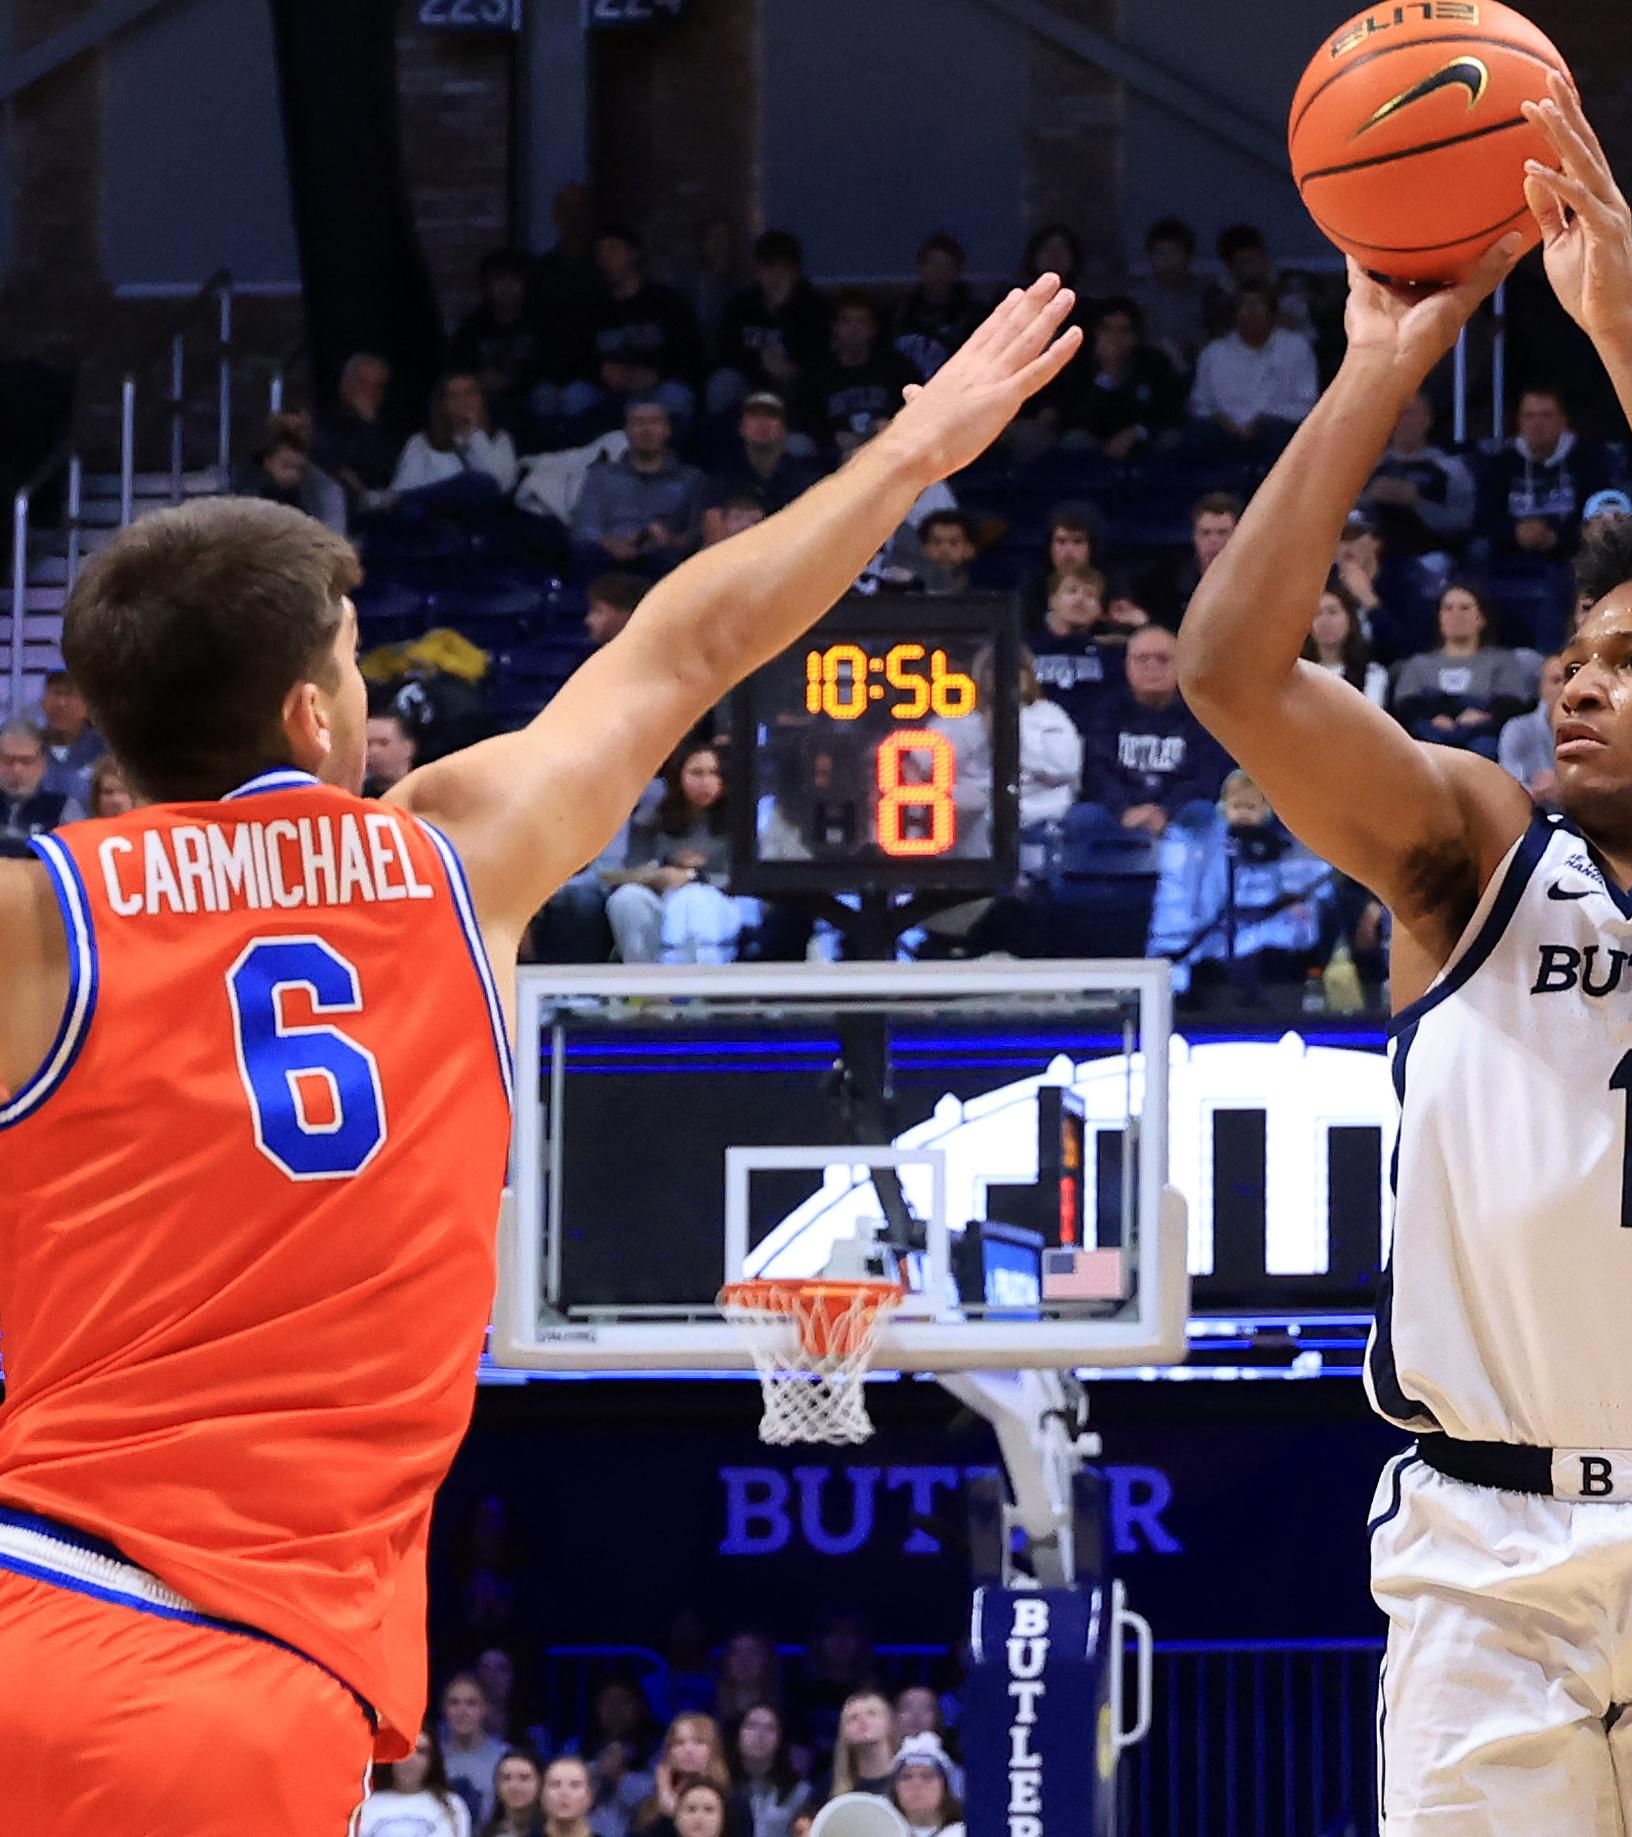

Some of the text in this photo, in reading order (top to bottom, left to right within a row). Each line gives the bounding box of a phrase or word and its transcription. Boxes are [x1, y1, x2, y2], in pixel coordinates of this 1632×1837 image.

[806, 644, 976, 719] 10:56
[876, 728, 956, 857] 8
[98, 813, 434, 917] CARMICHAEL
[225, 934, 388, 1182] 6
[718, 1466, 1184, 1556] BUTR
[1579, 1456, 1614, 1497] B
